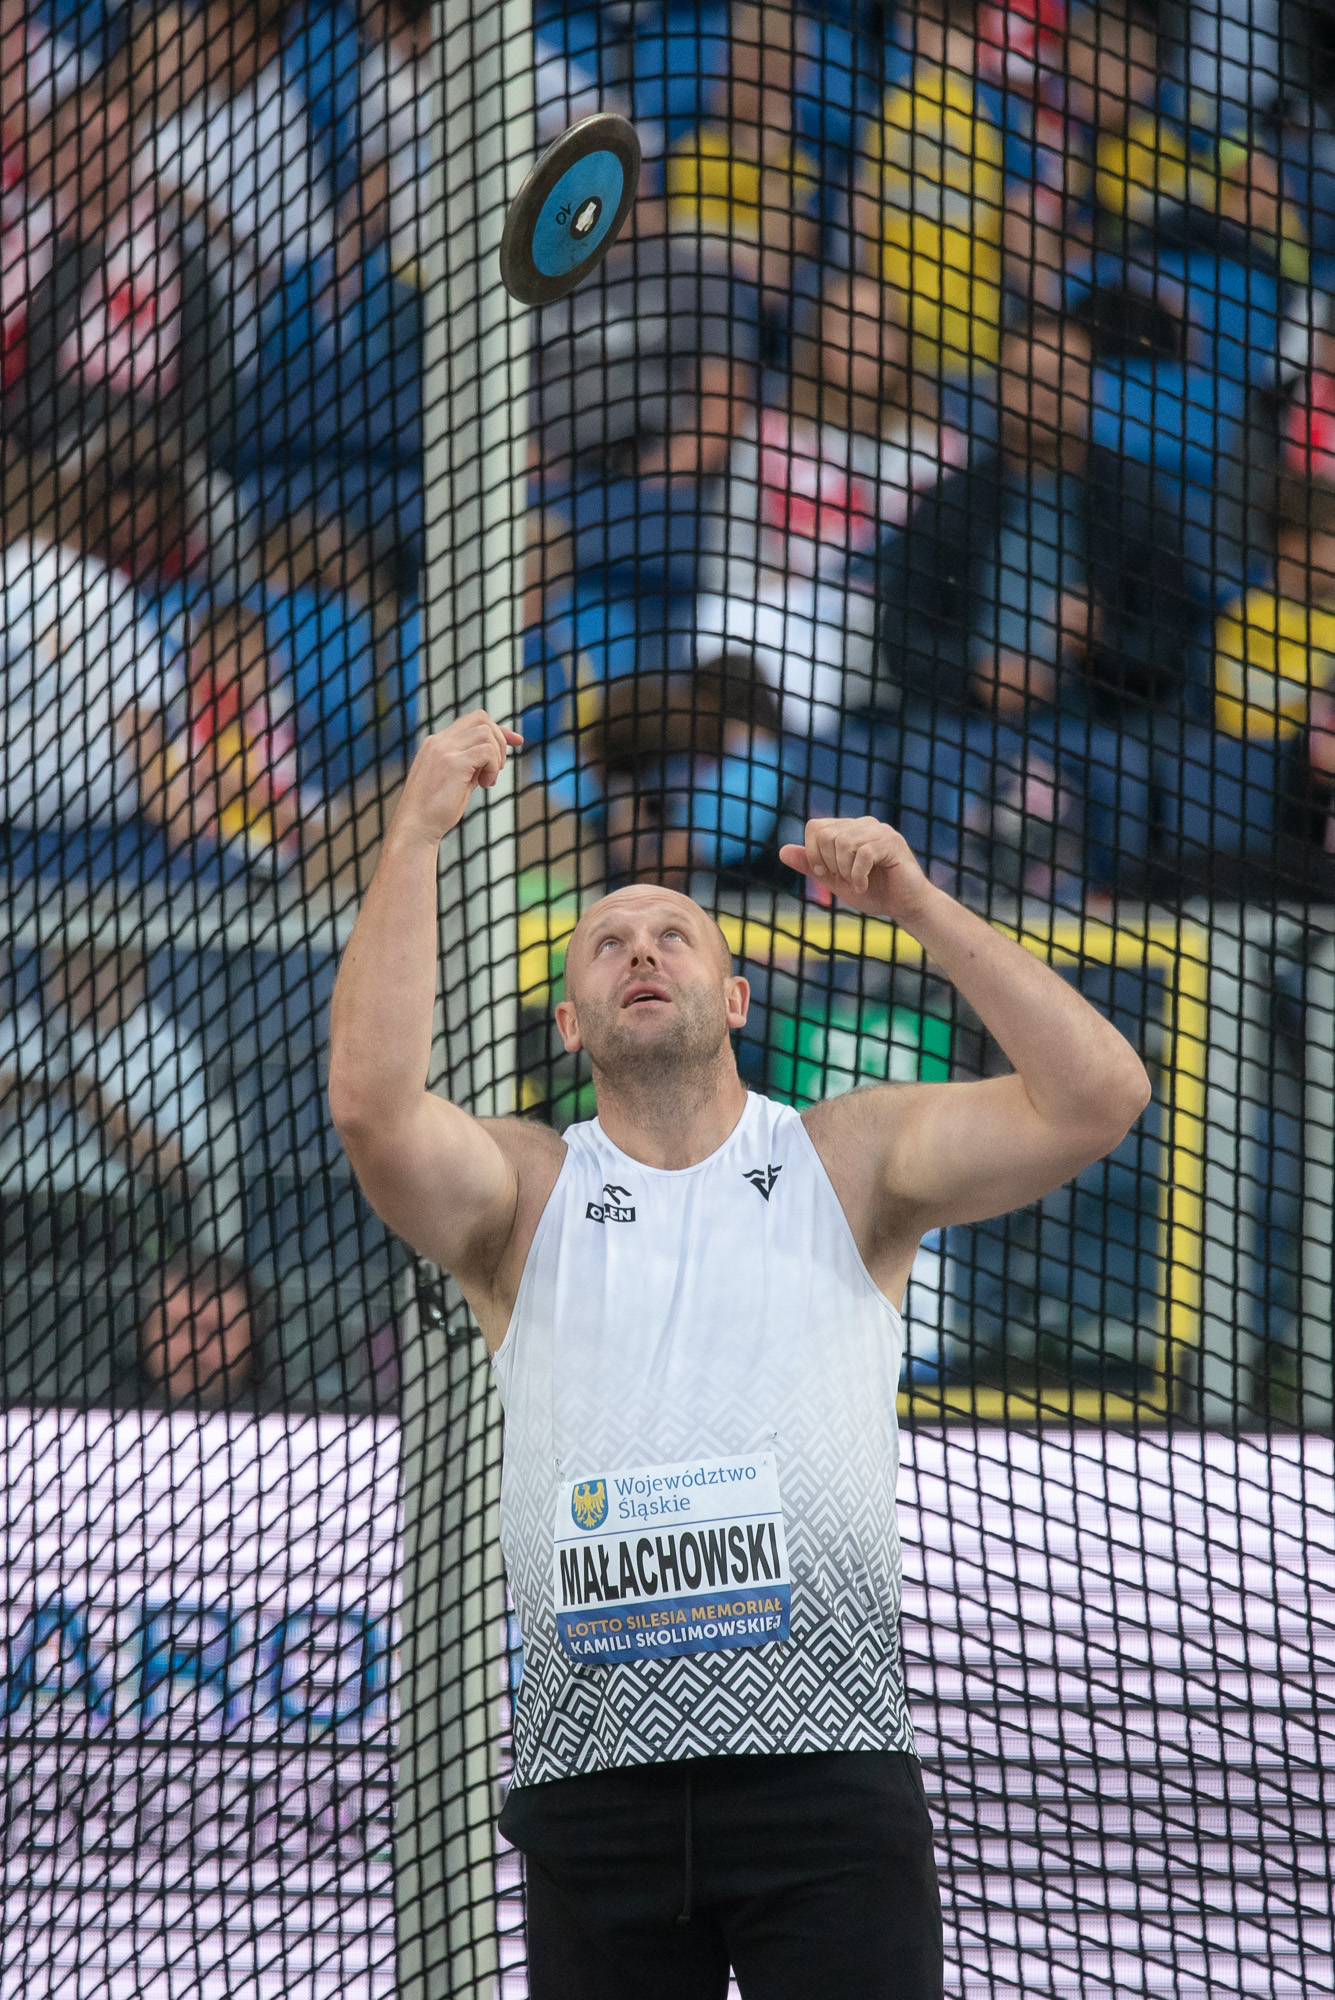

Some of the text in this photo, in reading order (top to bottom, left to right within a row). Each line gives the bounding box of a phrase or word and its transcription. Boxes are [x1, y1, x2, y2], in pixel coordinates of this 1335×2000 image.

[590, 1205, 632, 1221] OLEN
[614, 1466, 757, 1497] Województwo
[618, 1495, 691, 1521] Śląskie
[559, 1522, 782, 1607] MAŁACHOWSKI
[567, 1597, 783, 1639] LOTTO SILESIA MEMORIAŁ
[570, 1614, 782, 1656] KAMILI SKOLIMOWSKIEJ
